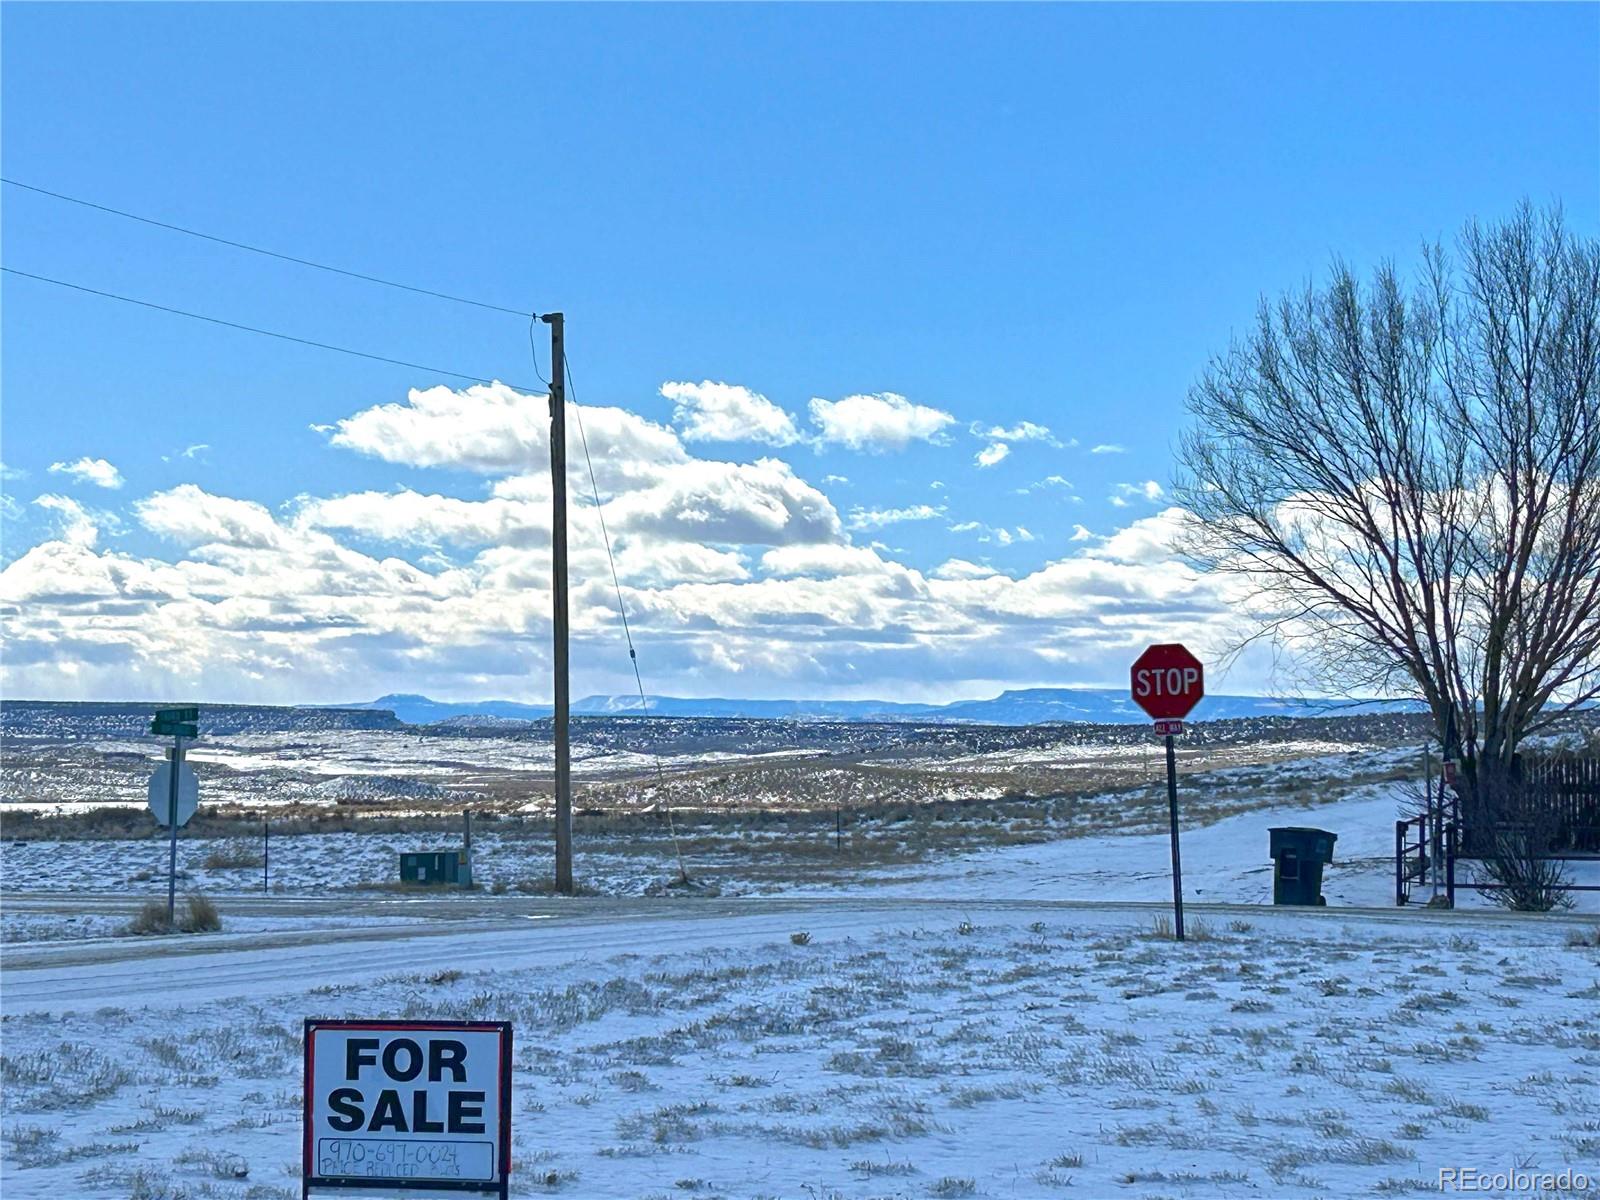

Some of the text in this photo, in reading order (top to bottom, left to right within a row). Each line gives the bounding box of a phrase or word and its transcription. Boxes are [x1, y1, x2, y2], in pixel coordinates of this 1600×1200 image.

[1136, 667, 1198, 697] STOP
[346, 1038, 467, 1083] FOR
[327, 1087, 486, 1134] SALE
